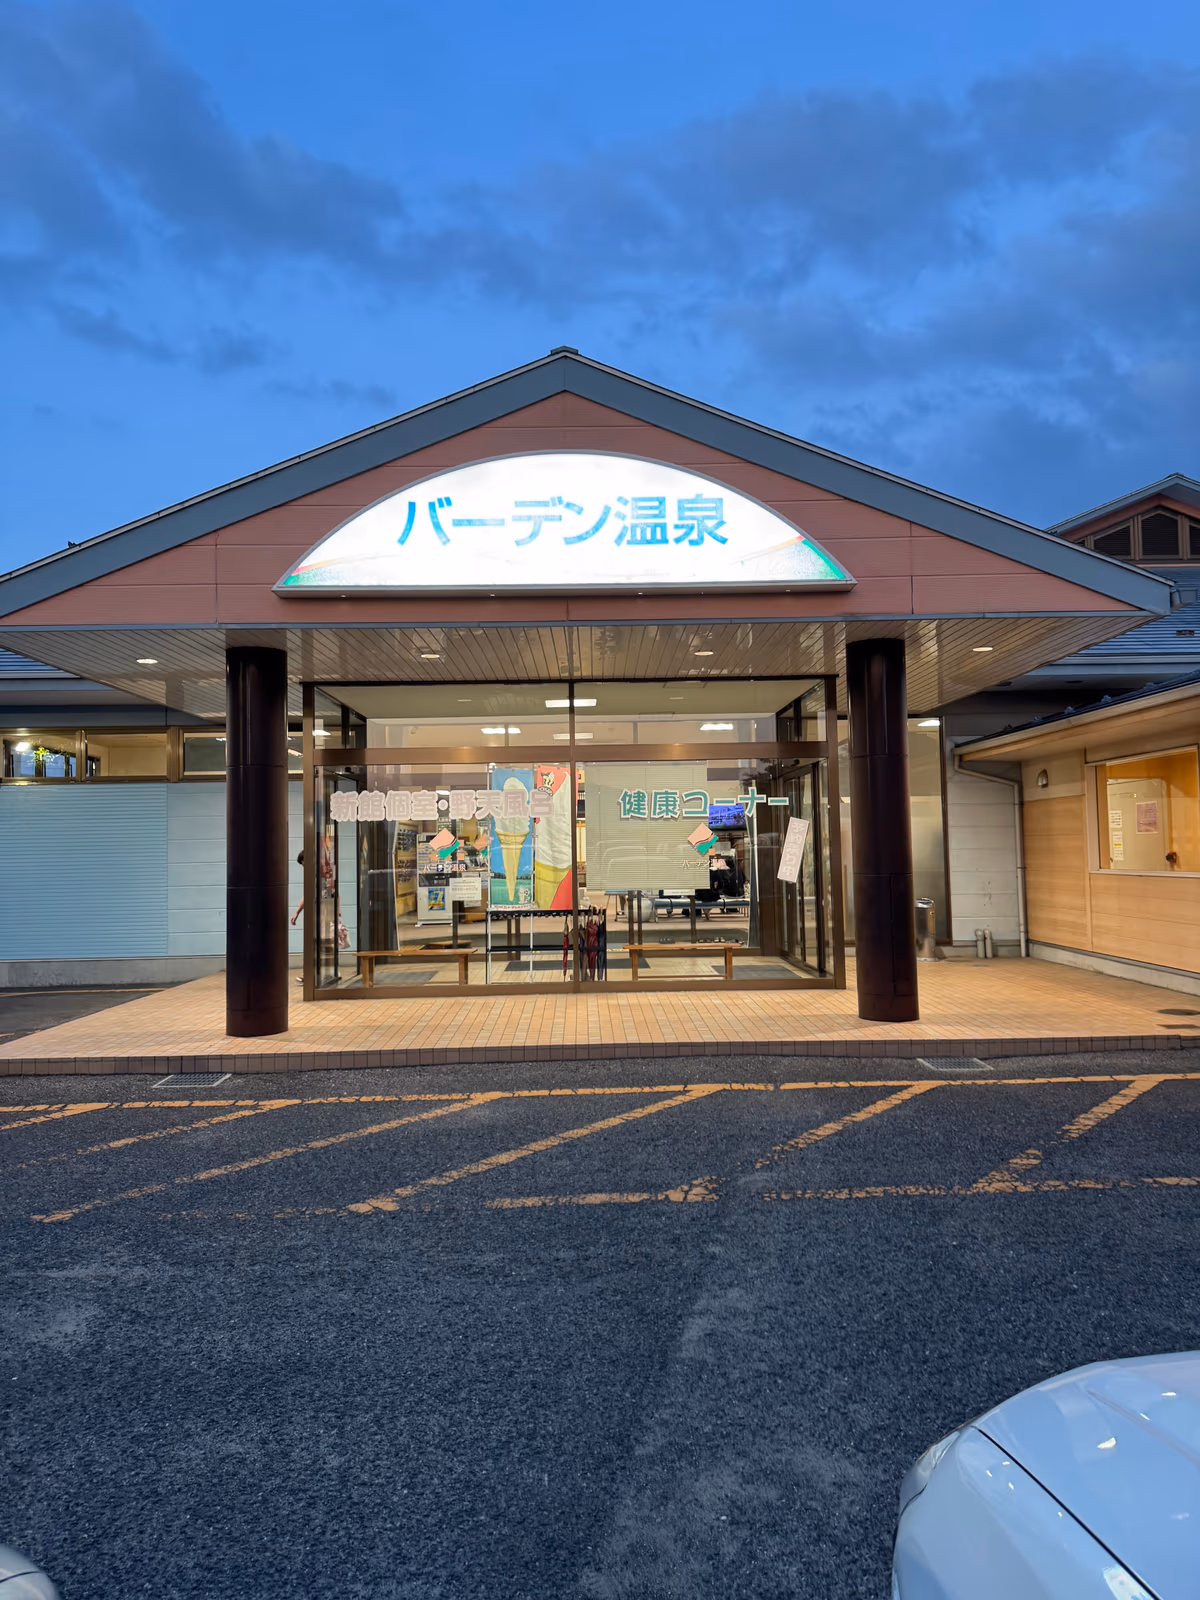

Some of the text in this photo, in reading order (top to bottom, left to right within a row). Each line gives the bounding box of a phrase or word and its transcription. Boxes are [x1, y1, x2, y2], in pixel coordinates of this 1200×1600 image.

[398, 493, 727, 546] バーデン温泉
[331, 789, 554, 821] 新館個室・野天風呂
[619, 787, 789, 819] 健康コーナー
